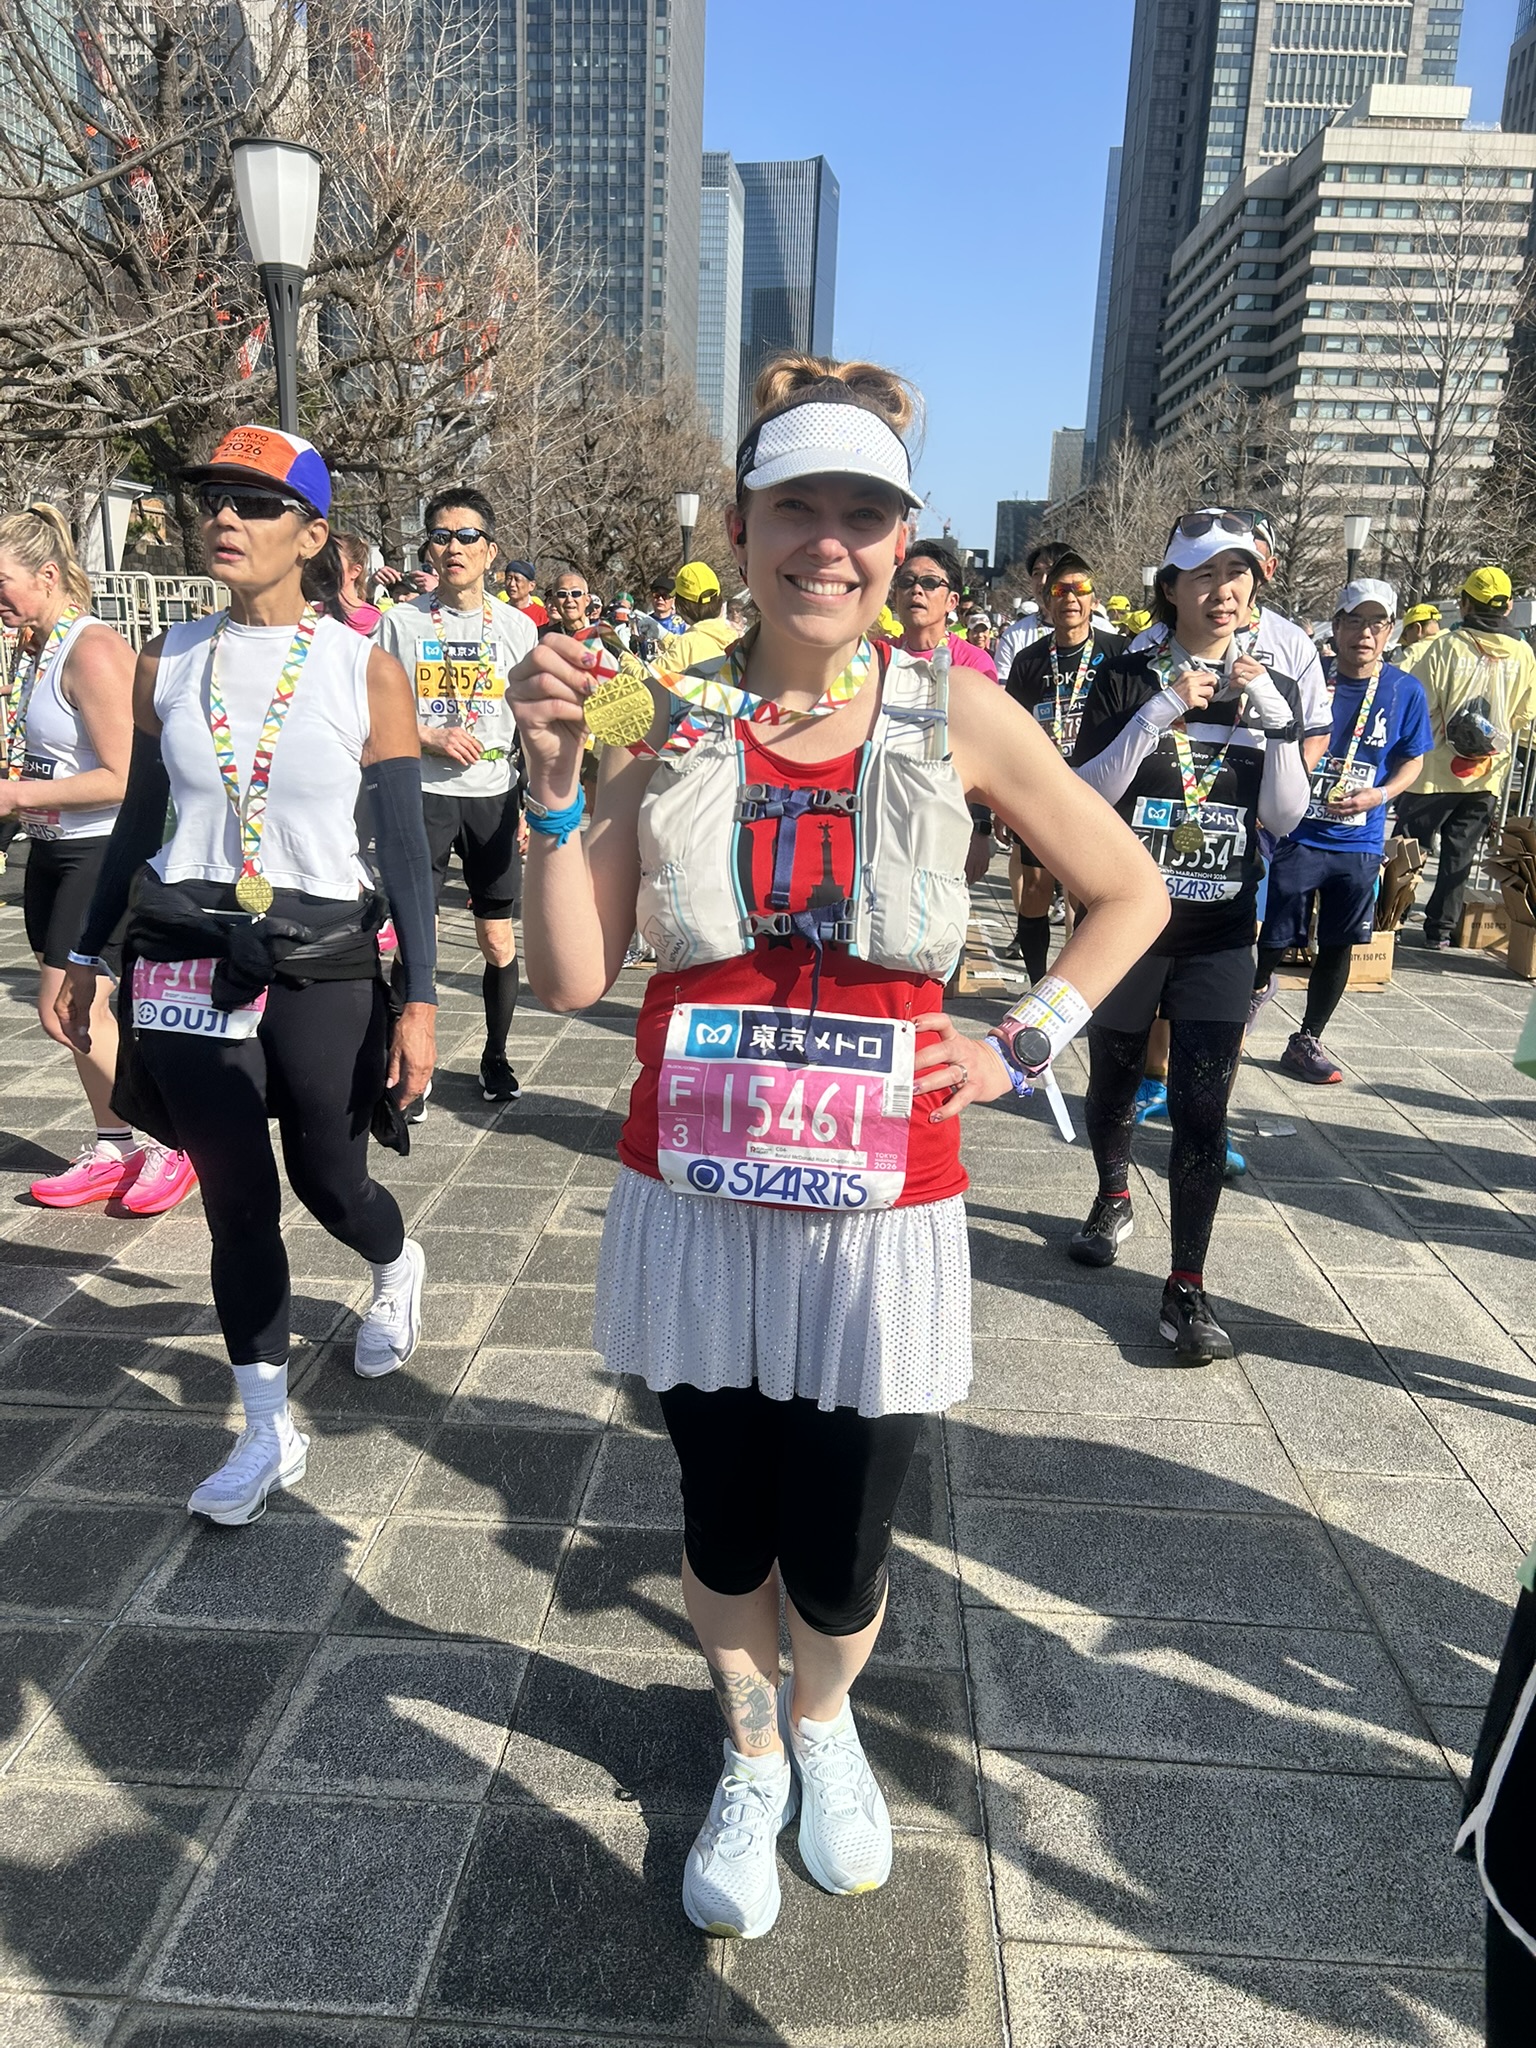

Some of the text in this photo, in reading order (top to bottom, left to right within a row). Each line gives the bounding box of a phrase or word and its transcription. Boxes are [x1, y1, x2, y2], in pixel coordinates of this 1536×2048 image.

[233, 432, 269, 442] TOKYO
[224, 442, 262, 455] 2026
[420, 668, 431, 681] D
[422, 687, 430, 697] 2
[1192, 751, 1209, 760] Tokyo
[1158, 867, 1175, 875] OKYO
[1176, 870, 1213, 879] MARATHON
[1363, 953, 1374, 961] 150
[1374, 952, 1387, 961] PCS
[161, 1005, 229, 1034] OUJI
[749, 1024, 883, 1060] 東京メトロ
[669, 1074, 696, 1107] F
[722, 1073, 866, 1146] 15461
[671, 1123, 689, 1148] 3
[874, 1152, 898, 1160] TOKYO
[874, 1162, 897, 1170] 2026
